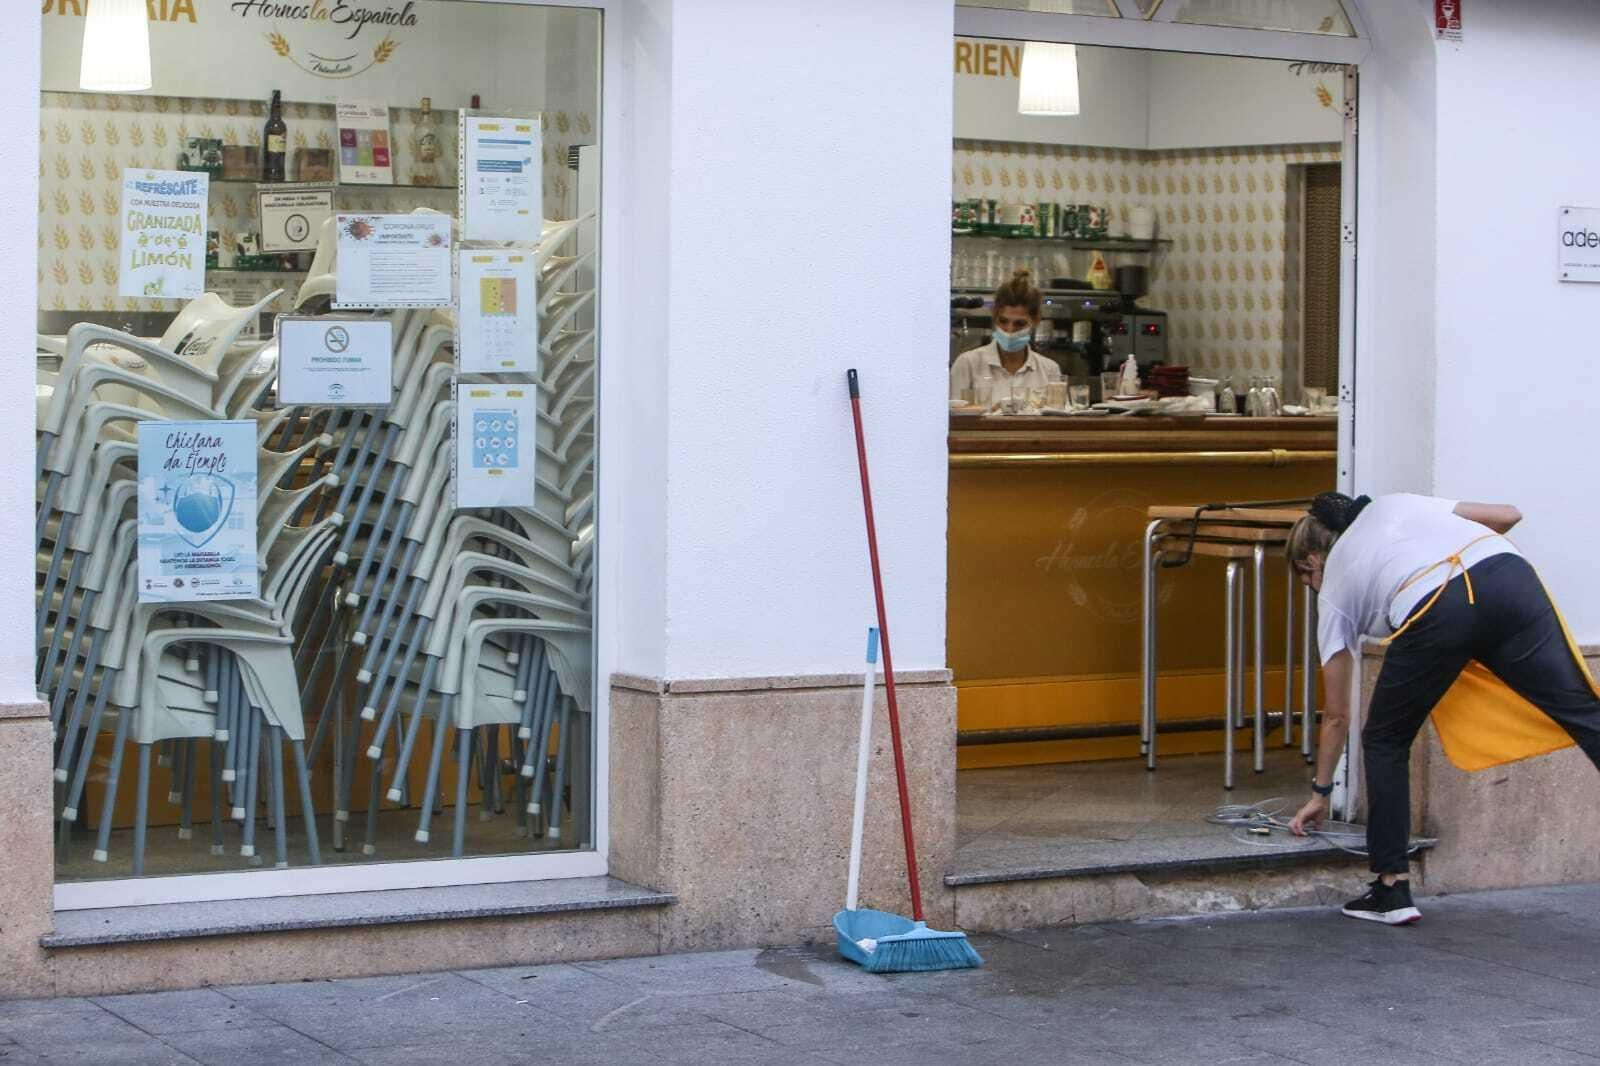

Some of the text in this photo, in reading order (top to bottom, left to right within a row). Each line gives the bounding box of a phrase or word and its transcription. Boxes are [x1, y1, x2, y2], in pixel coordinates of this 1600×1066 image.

[329, 1, 418, 40] Española
[134, 179, 198, 196] REFRÉSCATE
[127, 210, 203, 235] GRANIZADA
[1562, 227, 1600, 249] ade
[131, 250, 193, 272] LIMÓN
[166, 431, 224, 452] Chiclana
[163, 448, 227, 476] da Ejemplo
